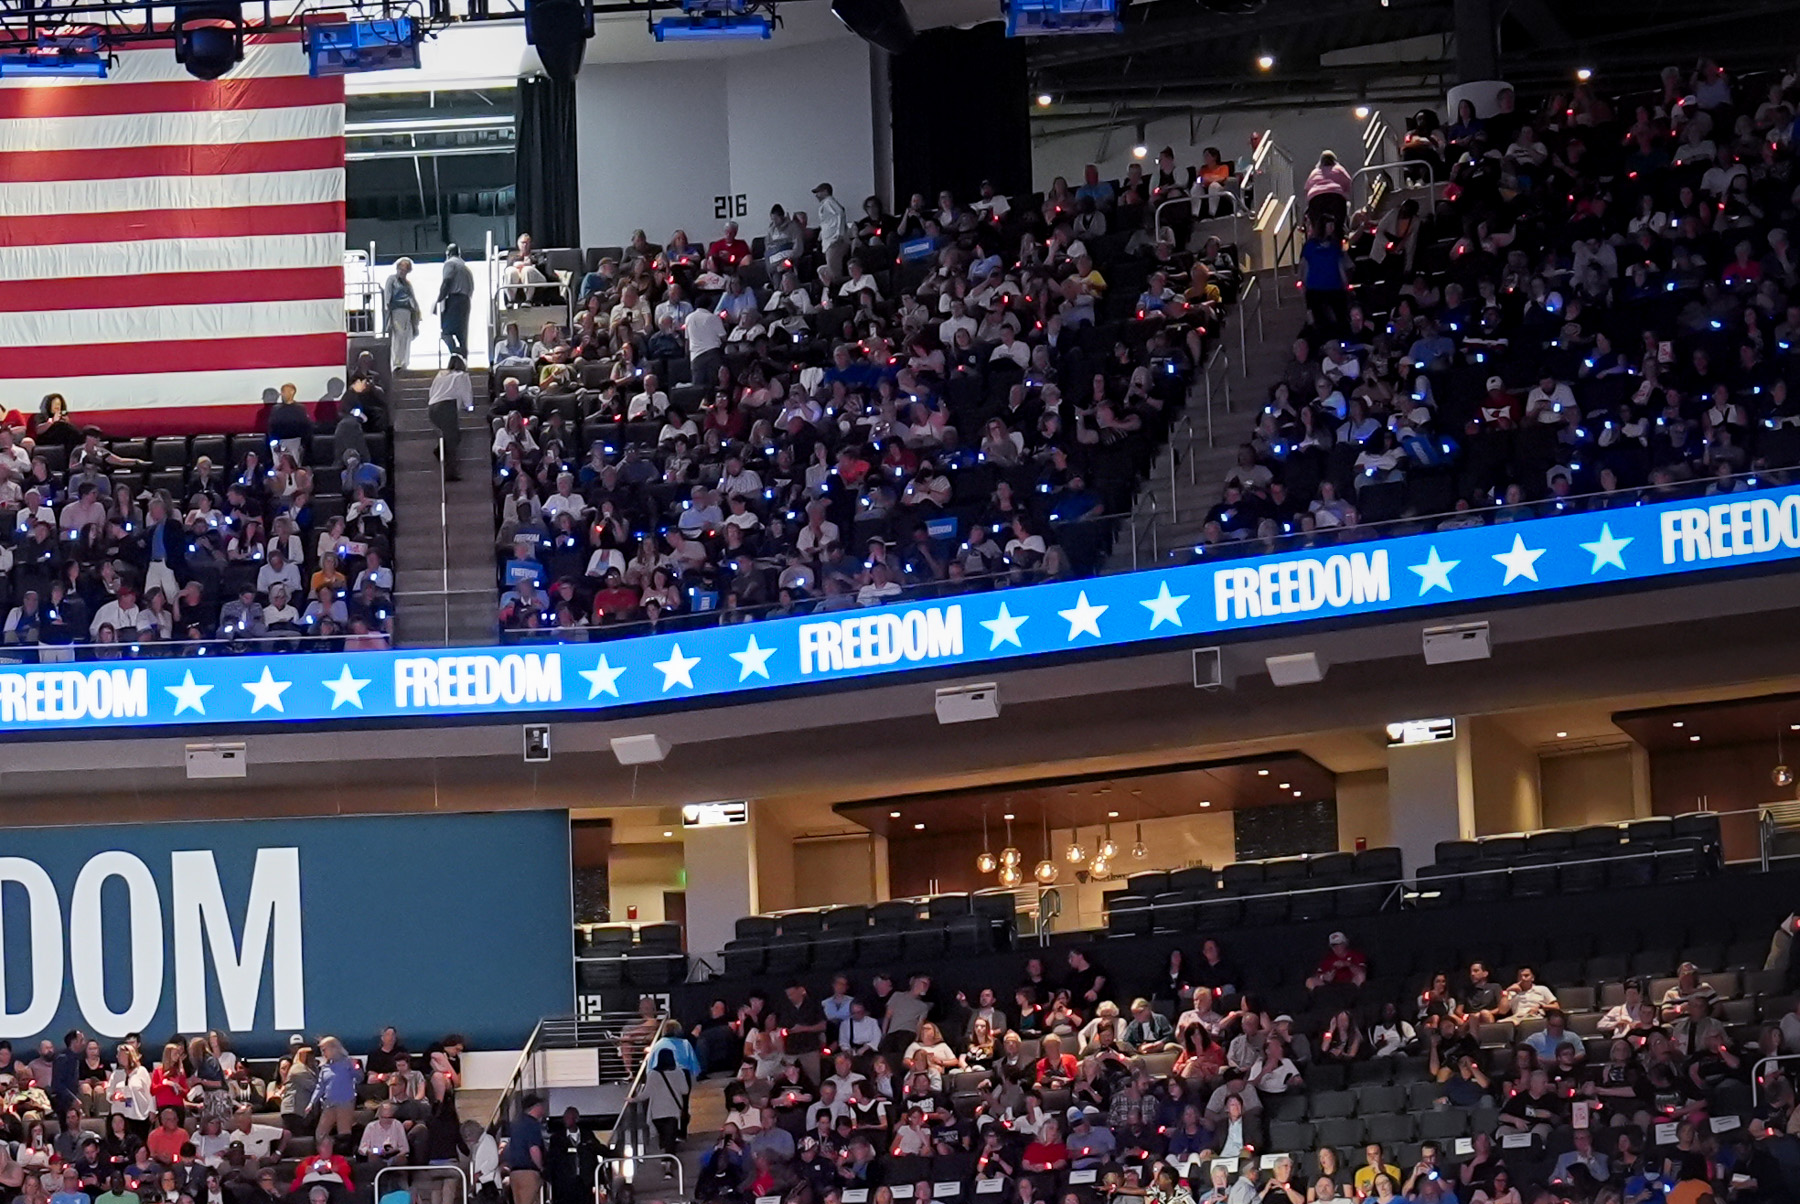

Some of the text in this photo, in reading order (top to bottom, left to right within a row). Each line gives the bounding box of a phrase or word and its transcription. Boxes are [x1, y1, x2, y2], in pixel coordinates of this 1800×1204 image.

[715, 195, 748, 219] 216
[1663, 498, 1800, 562] FREEDO
[1216, 551, 1388, 620] FREEDOM
[801, 606, 962, 673] FREEDOM
[396, 654, 561, 706] FREEDOM
